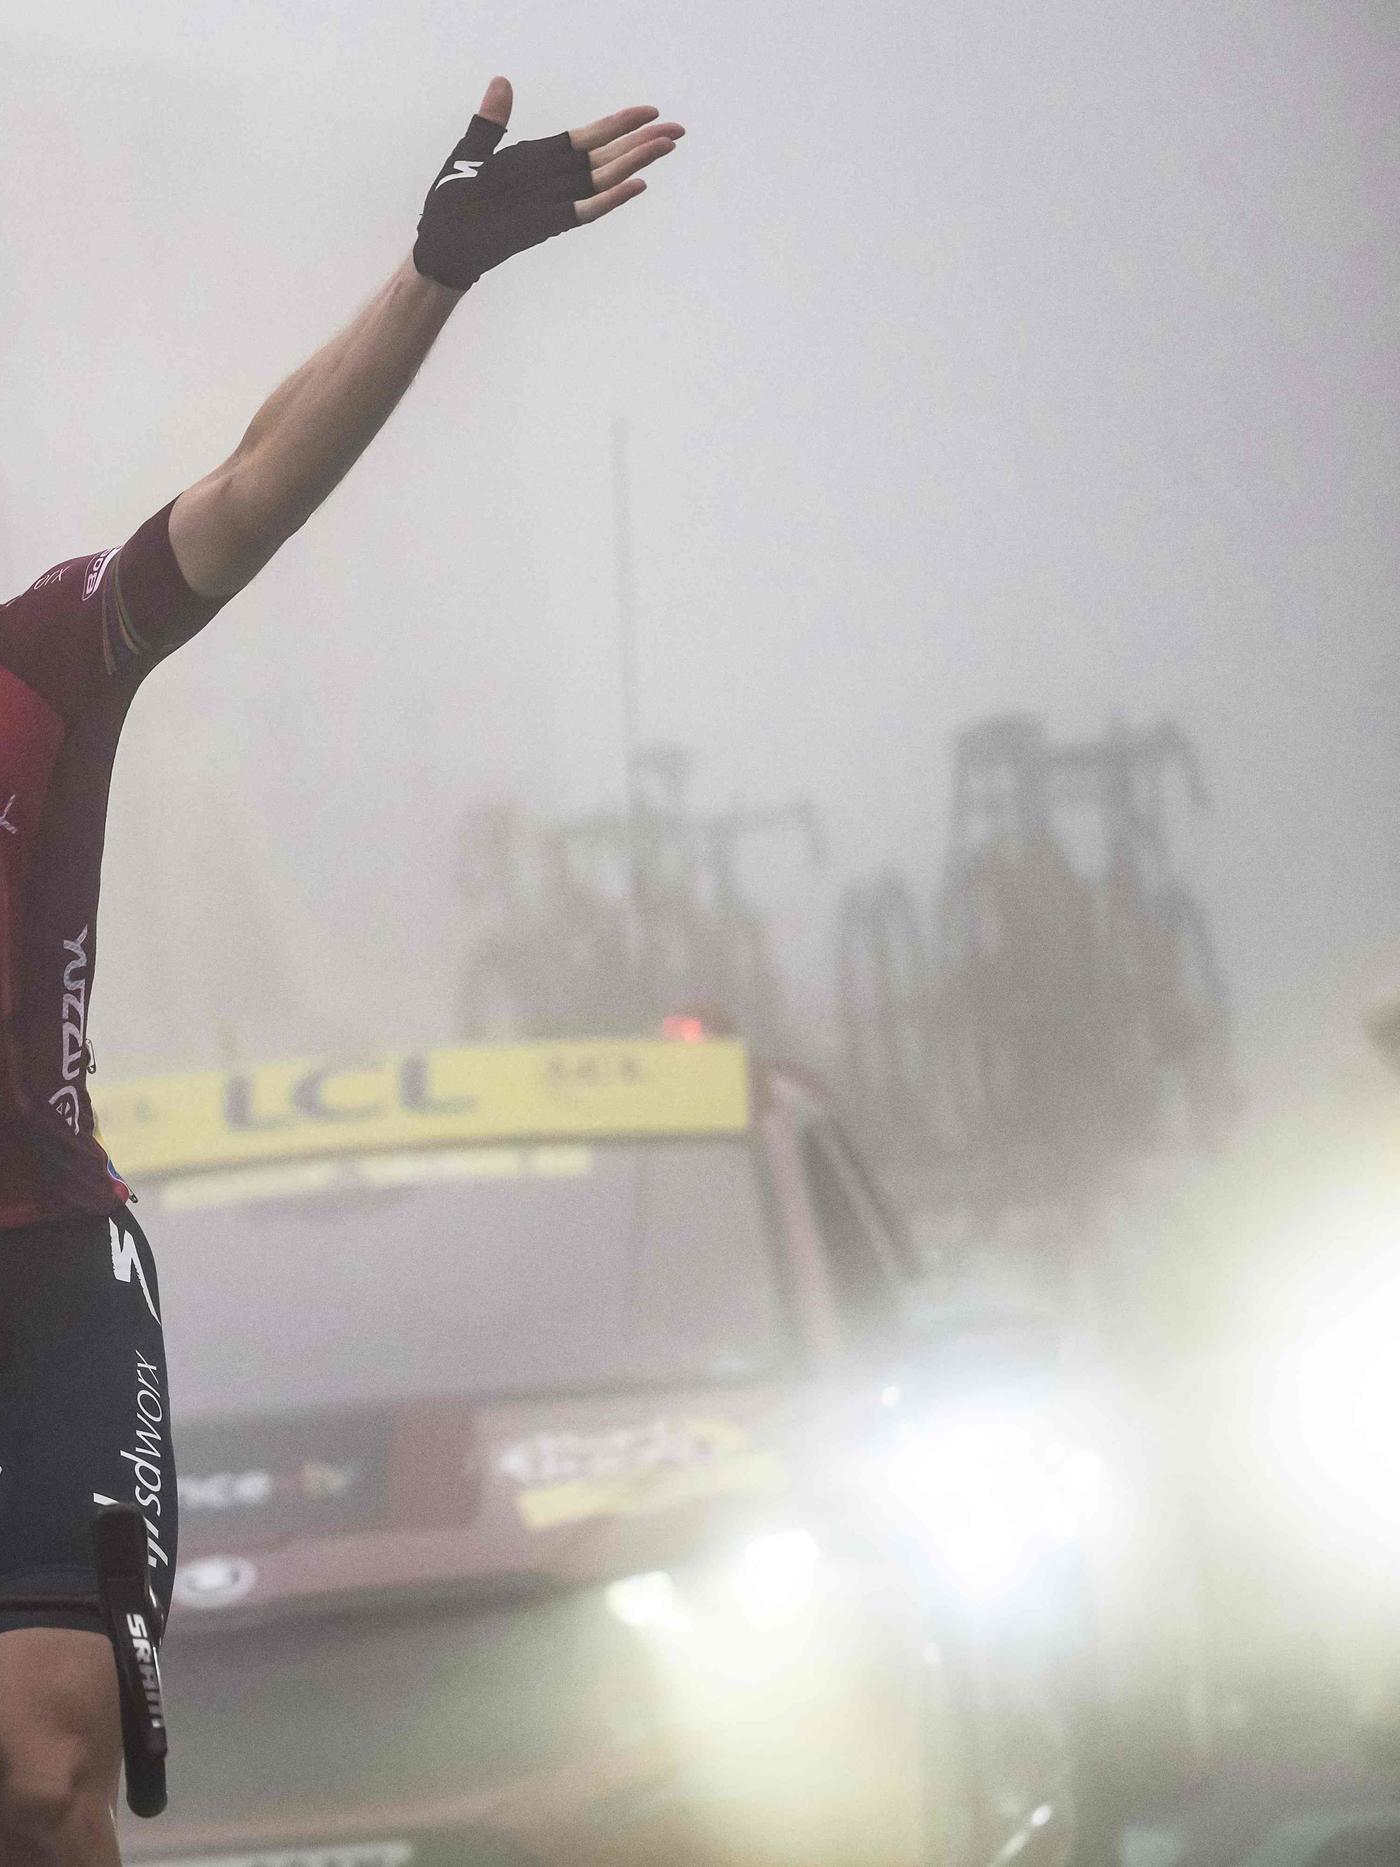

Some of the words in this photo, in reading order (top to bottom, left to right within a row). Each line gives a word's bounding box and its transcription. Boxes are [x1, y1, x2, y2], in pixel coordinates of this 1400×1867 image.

[224, 1053, 477, 1133] LCL
[119, 1349, 163, 1517] sdworx
[125, 1612, 166, 1730] SRAM
